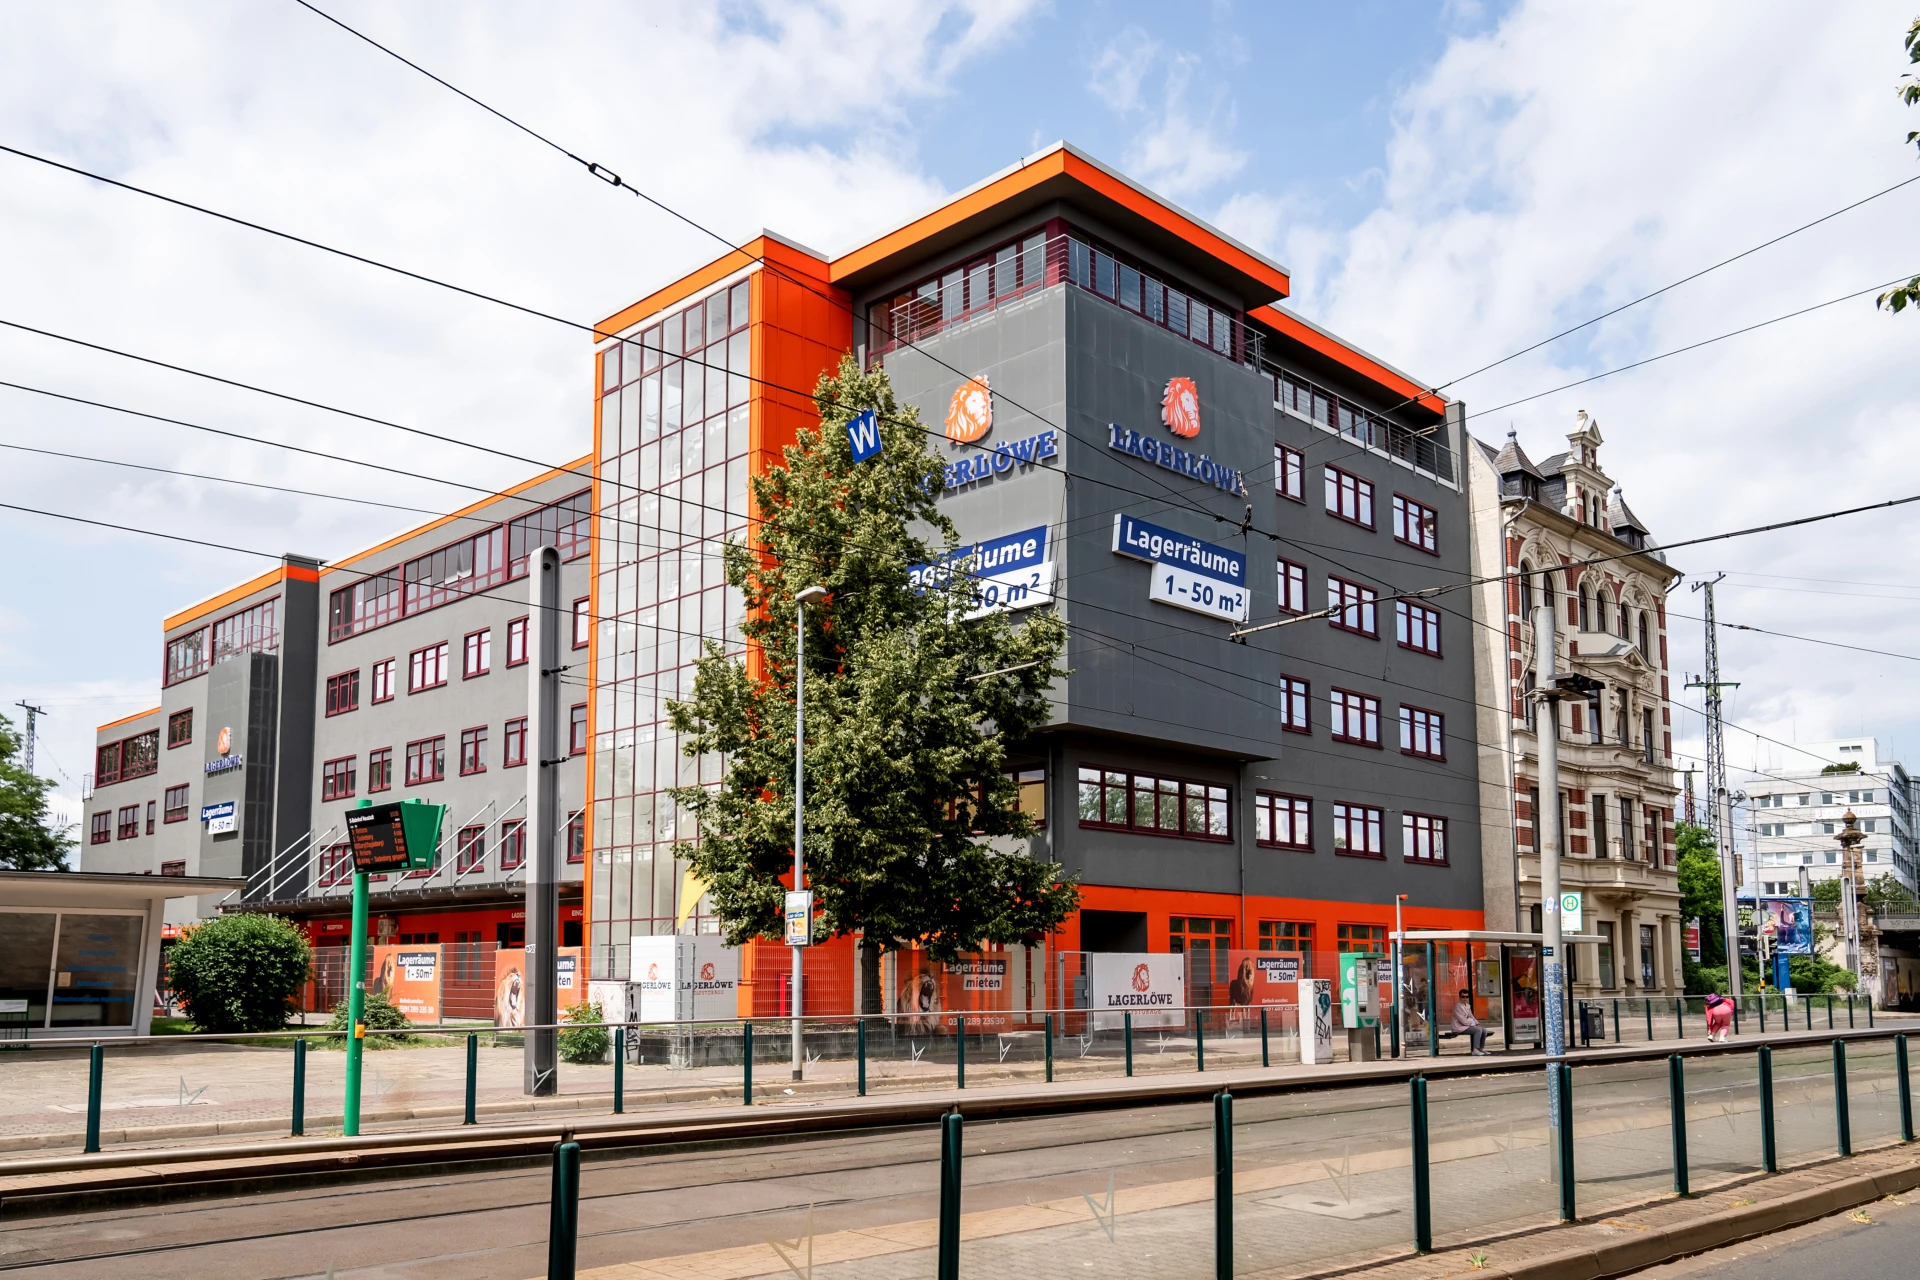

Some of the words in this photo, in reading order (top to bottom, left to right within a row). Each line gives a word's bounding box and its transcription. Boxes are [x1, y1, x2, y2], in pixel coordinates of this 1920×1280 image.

[849, 415, 875, 455] W
[1126, 521, 1240, 578] Lagerräume
[202, 804, 233, 820] Lagerräume
[397, 953, 436, 967] Lagerräume
[943, 960, 1004, 975] Lagerräume
[1257, 958, 1298, 971] Lagerräume
[965, 976, 1000, 988] mieten
[1108, 991, 1173, 1006] LAGERLÖWE
